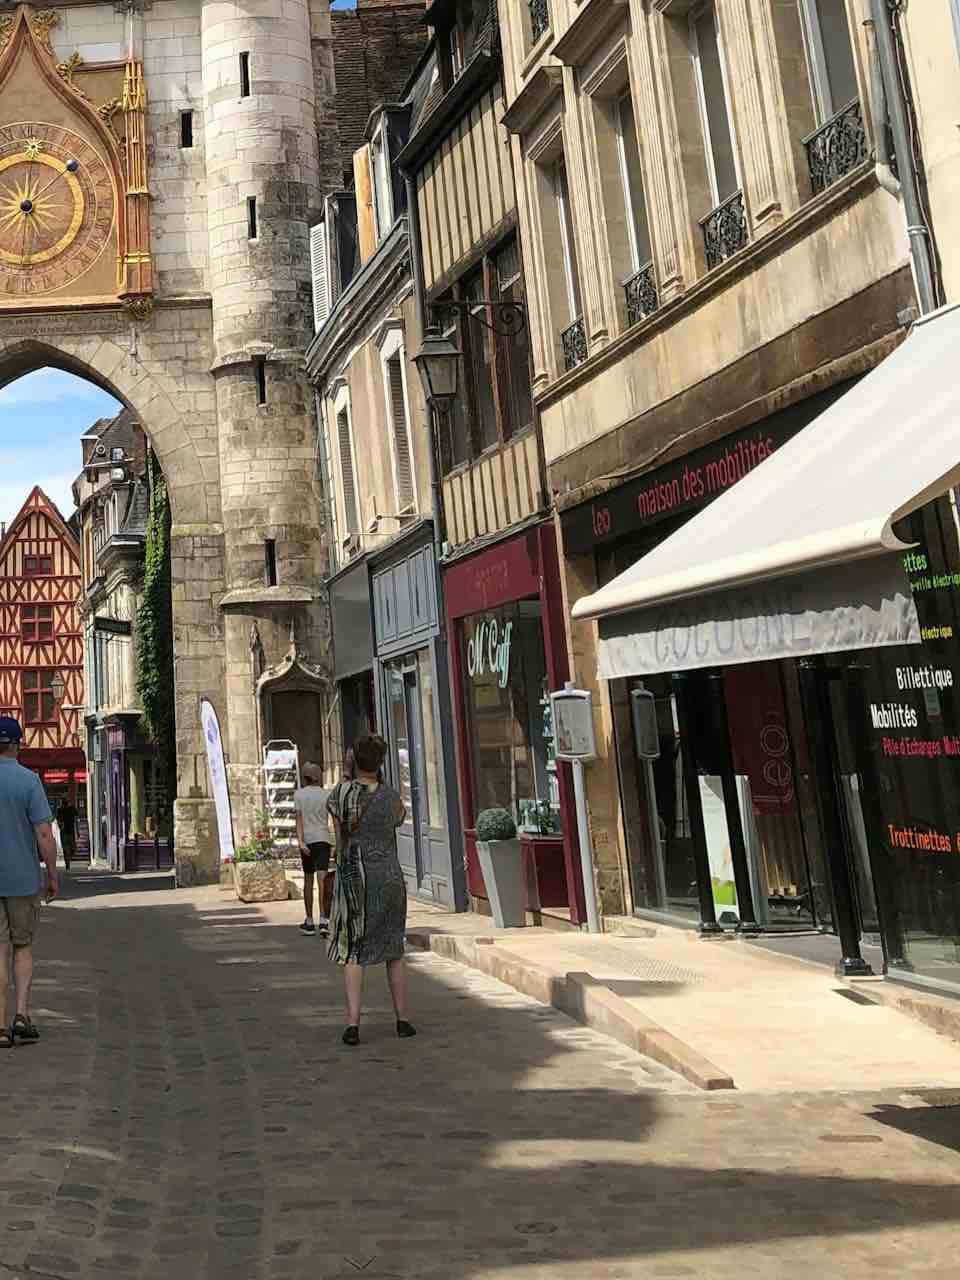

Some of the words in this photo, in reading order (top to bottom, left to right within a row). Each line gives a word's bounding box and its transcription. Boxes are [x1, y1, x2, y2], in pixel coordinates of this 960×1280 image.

[638, 477, 681, 517] maison
[682, 463, 705, 501] des
[895, 664, 953, 691] Billettique
[870, 703, 918, 728] Mobilités
[888, 824, 952, 854] Trottinettes
